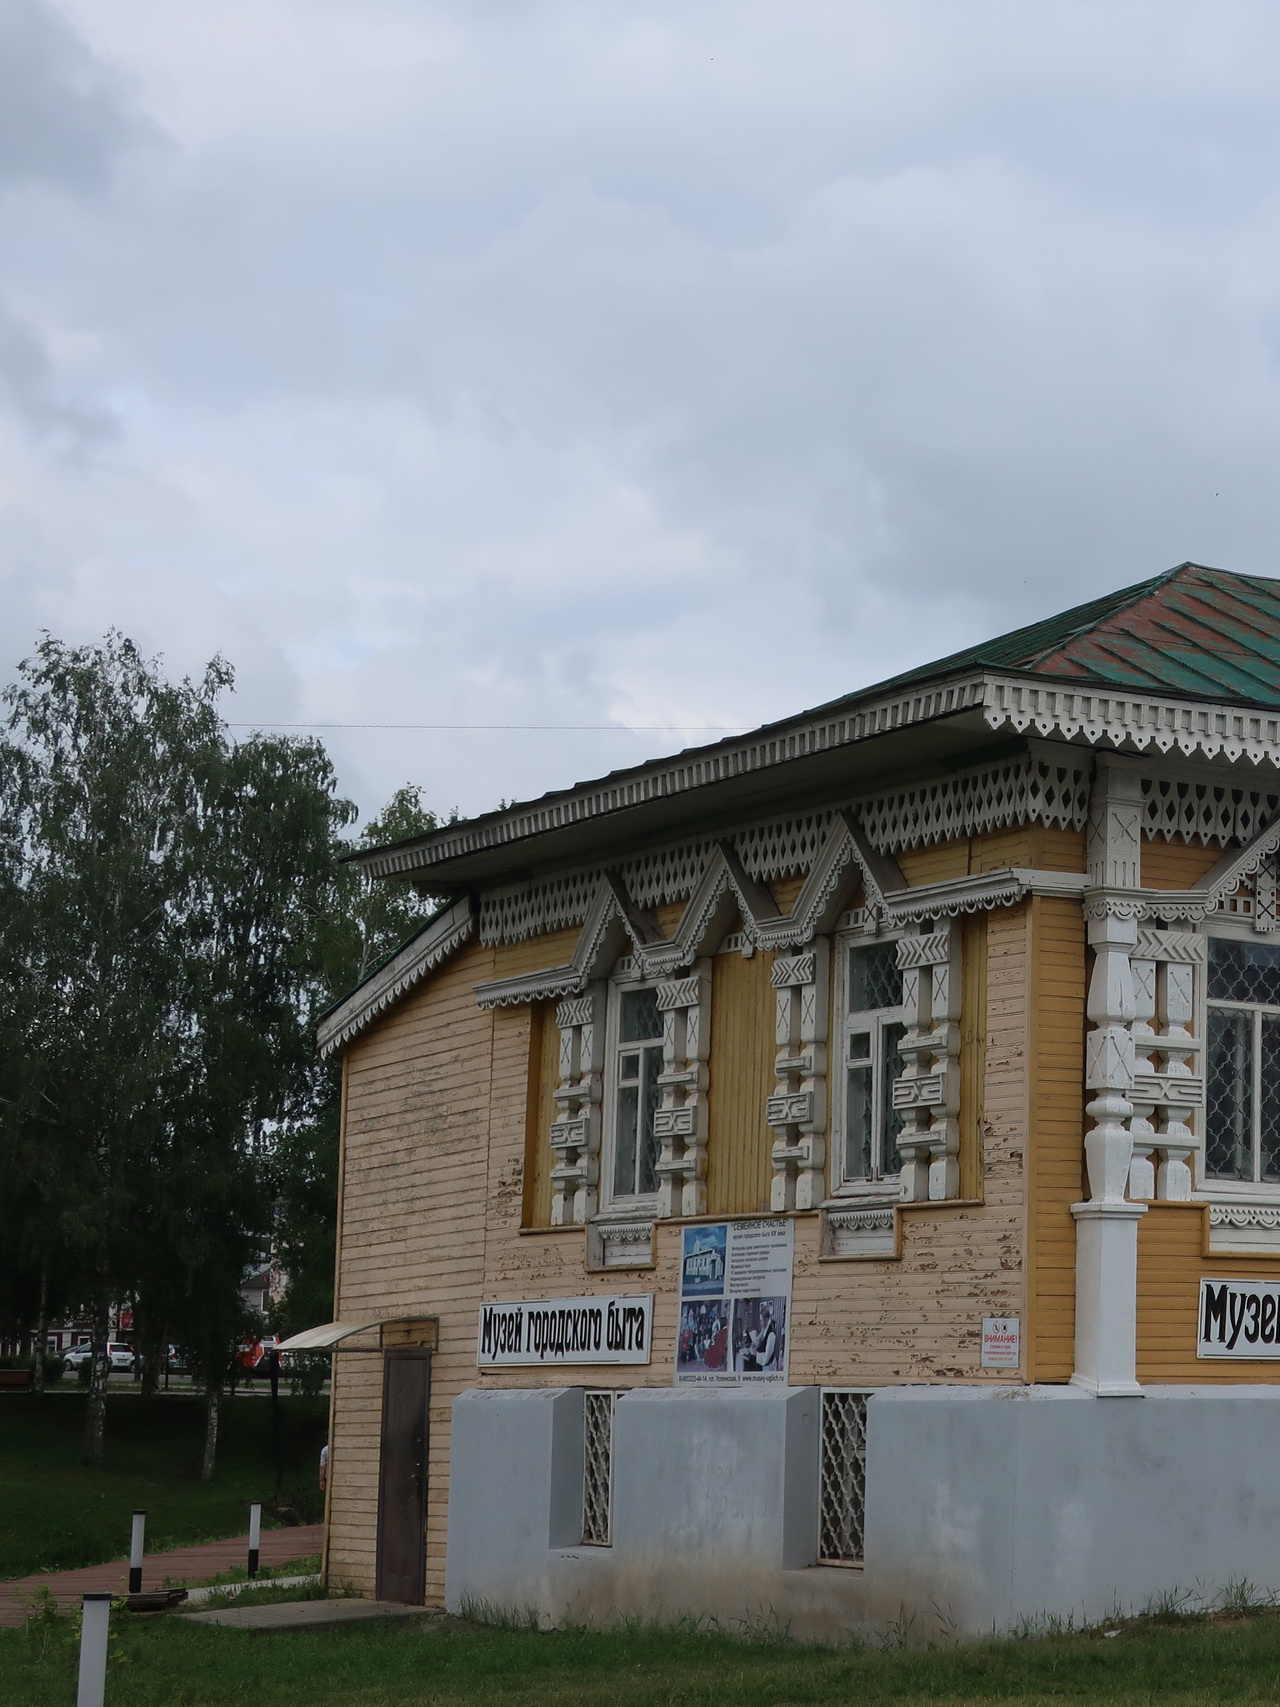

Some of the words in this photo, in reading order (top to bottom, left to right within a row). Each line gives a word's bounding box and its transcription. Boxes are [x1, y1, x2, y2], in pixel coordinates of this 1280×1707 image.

[481, 1306, 523, 1361] Музей
[525, 1308, 603, 1360] городского
[606, 1300, 645, 1351] быта
[984, 1334, 1018, 1343] ВНИМАНИЕ!
